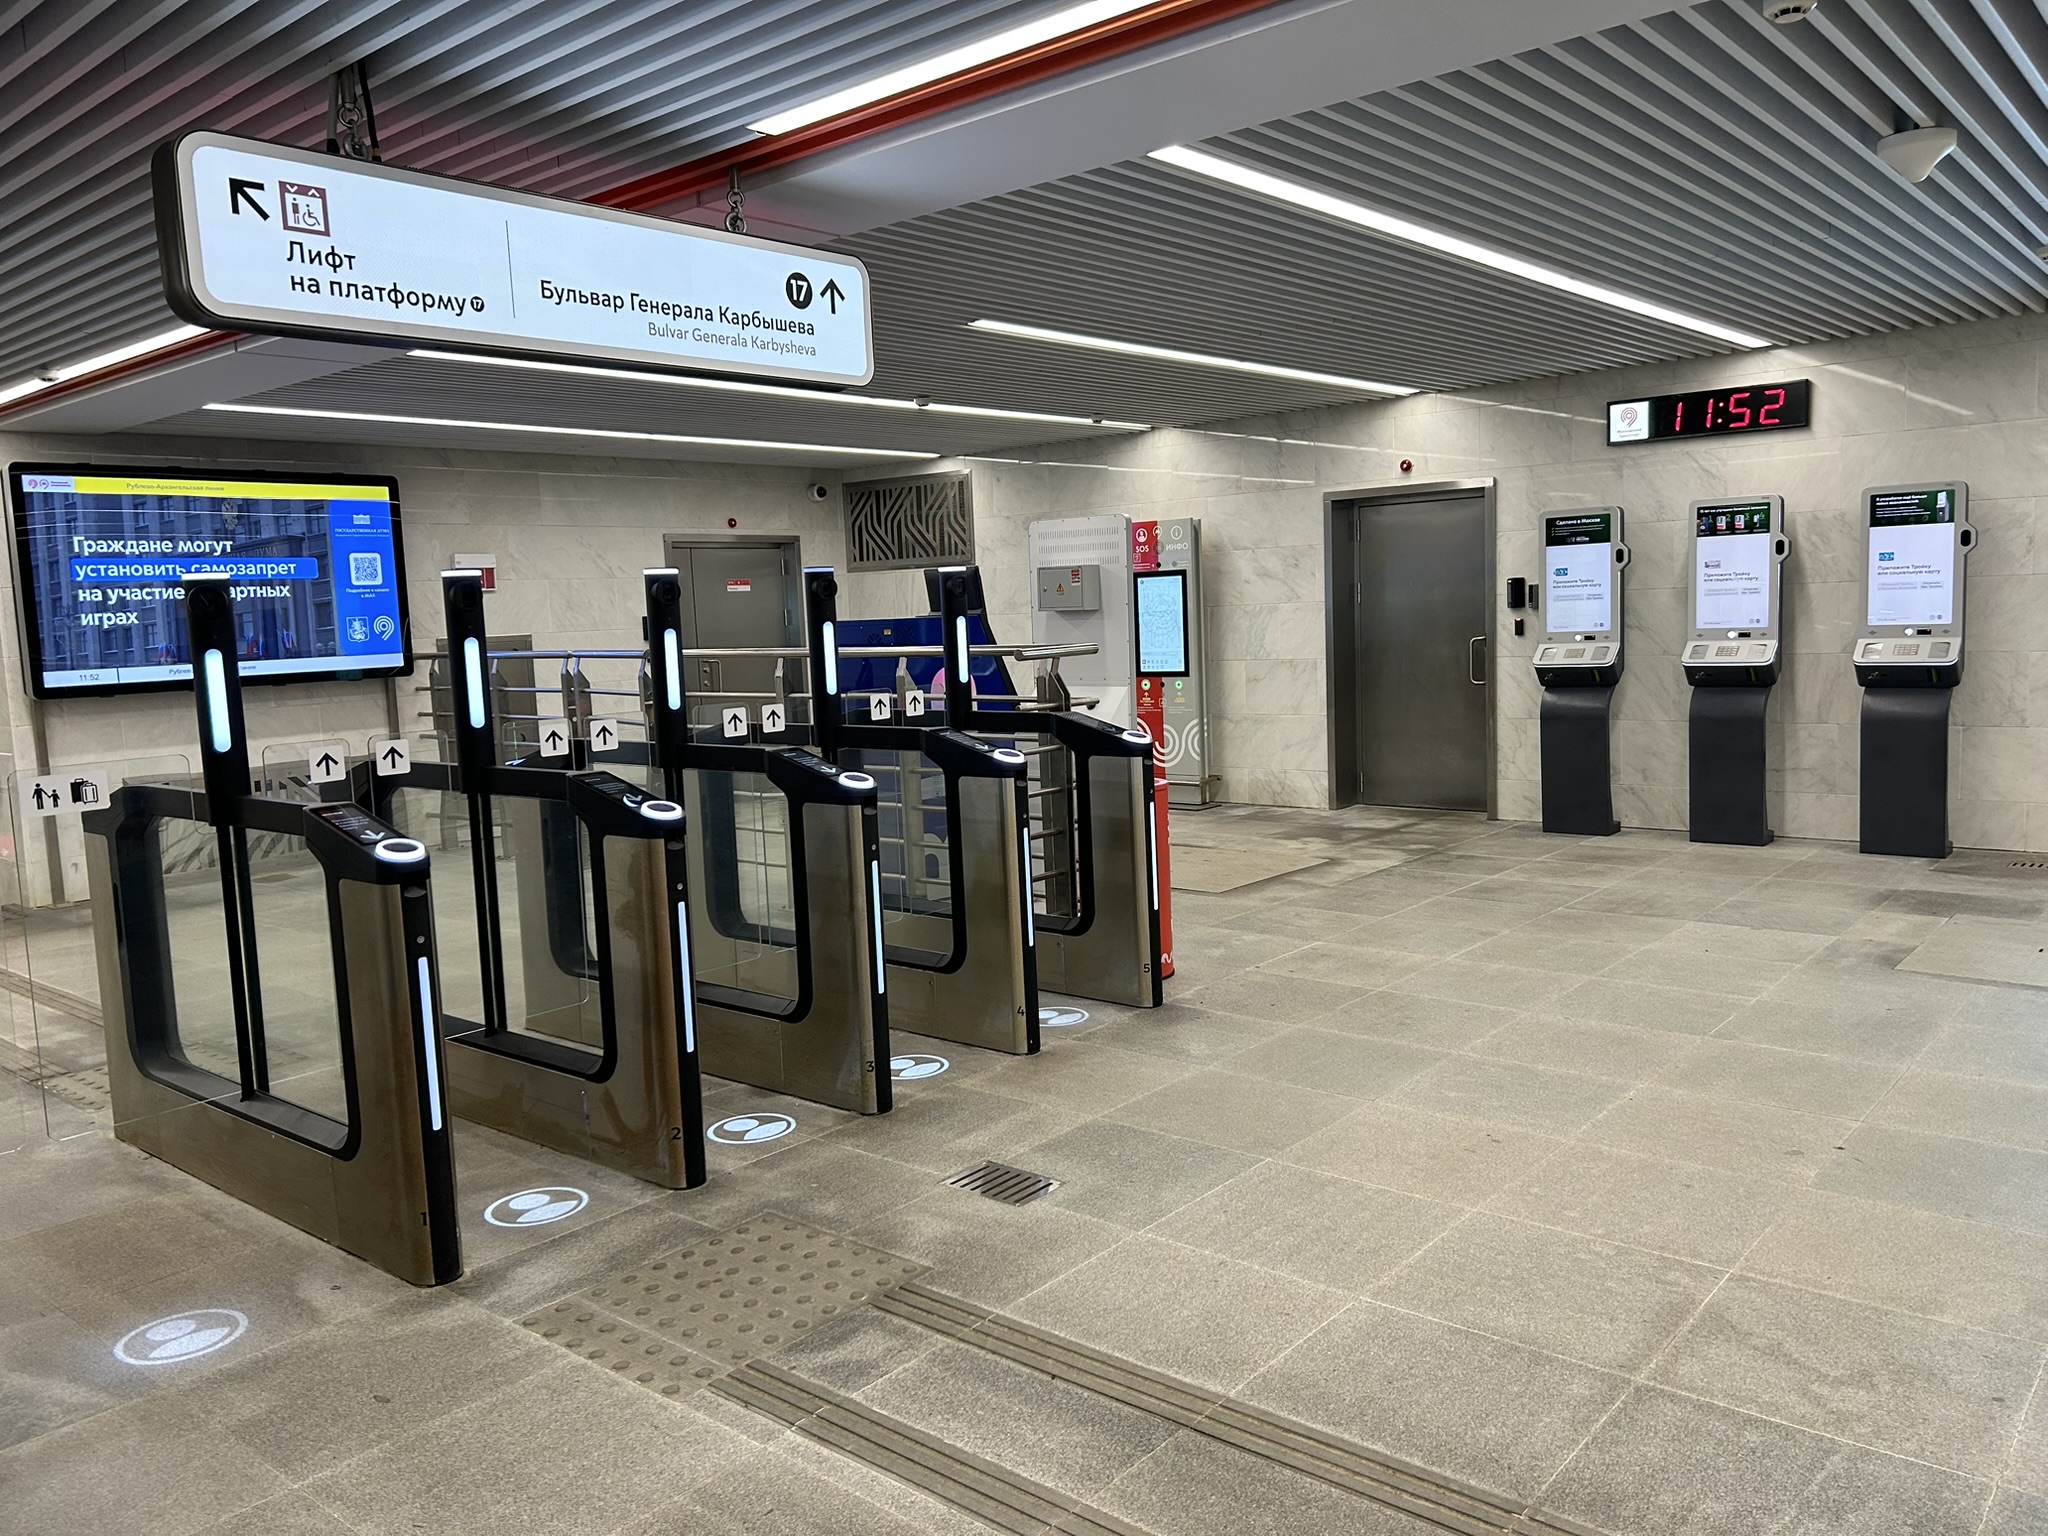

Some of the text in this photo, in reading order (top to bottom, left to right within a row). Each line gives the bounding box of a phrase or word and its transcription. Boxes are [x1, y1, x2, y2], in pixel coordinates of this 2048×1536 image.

[287, 240, 356, 274] Лифт
[290, 275, 484, 317] на платформу 17
[788, 277, 810, 304] 17
[540, 279, 815, 336] Бульвар Генерала Карбышева
[648, 322, 816, 356] Bulvar Generala Karbysheva
[1675, 388, 1786, 432] 11:52
[72, 536, 233, 556] Граждане могут
[1136, 544, 1150, 553] SOS
[1166, 542, 1189, 551] ИНФО
[74, 564, 186, 581] установить
[78, 586, 291, 604] на участие артных
[81, 611, 140, 628] играх
[79, 674, 100, 682] 11:52
[1144, 963, 1150, 973] 5
[1017, 1006, 1026, 1016] 4
[865, 1060, 874, 1072] 3
[672, 1127, 682, 1140] 2
[420, 1212, 427, 1226] 1
